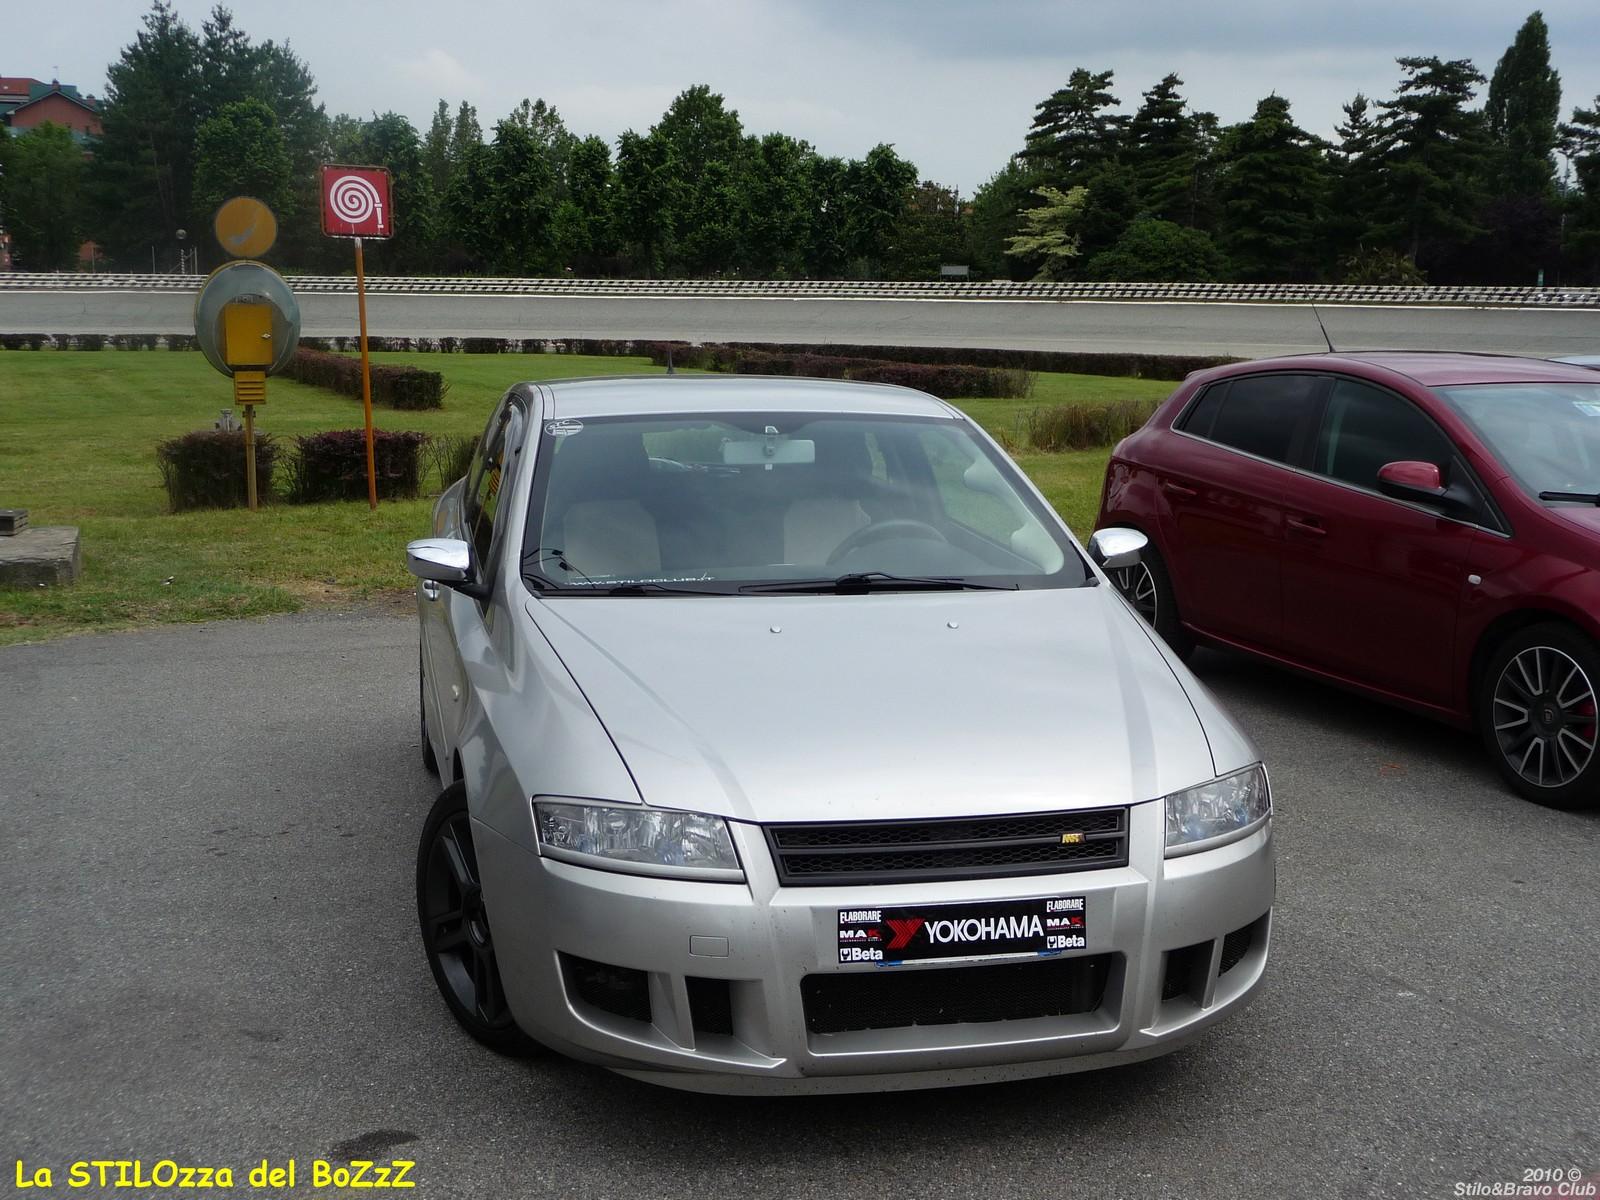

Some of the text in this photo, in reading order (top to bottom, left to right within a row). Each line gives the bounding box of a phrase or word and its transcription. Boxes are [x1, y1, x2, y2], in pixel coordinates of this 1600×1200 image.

[1046, 898, 1083, 912] ELABORARE
[840, 910, 881, 924] ELABORARE
[924, 914, 1044, 943] YOKOHAMA
[1057, 934, 1085, 948] Beta
[851, 947, 883, 961] Beta
